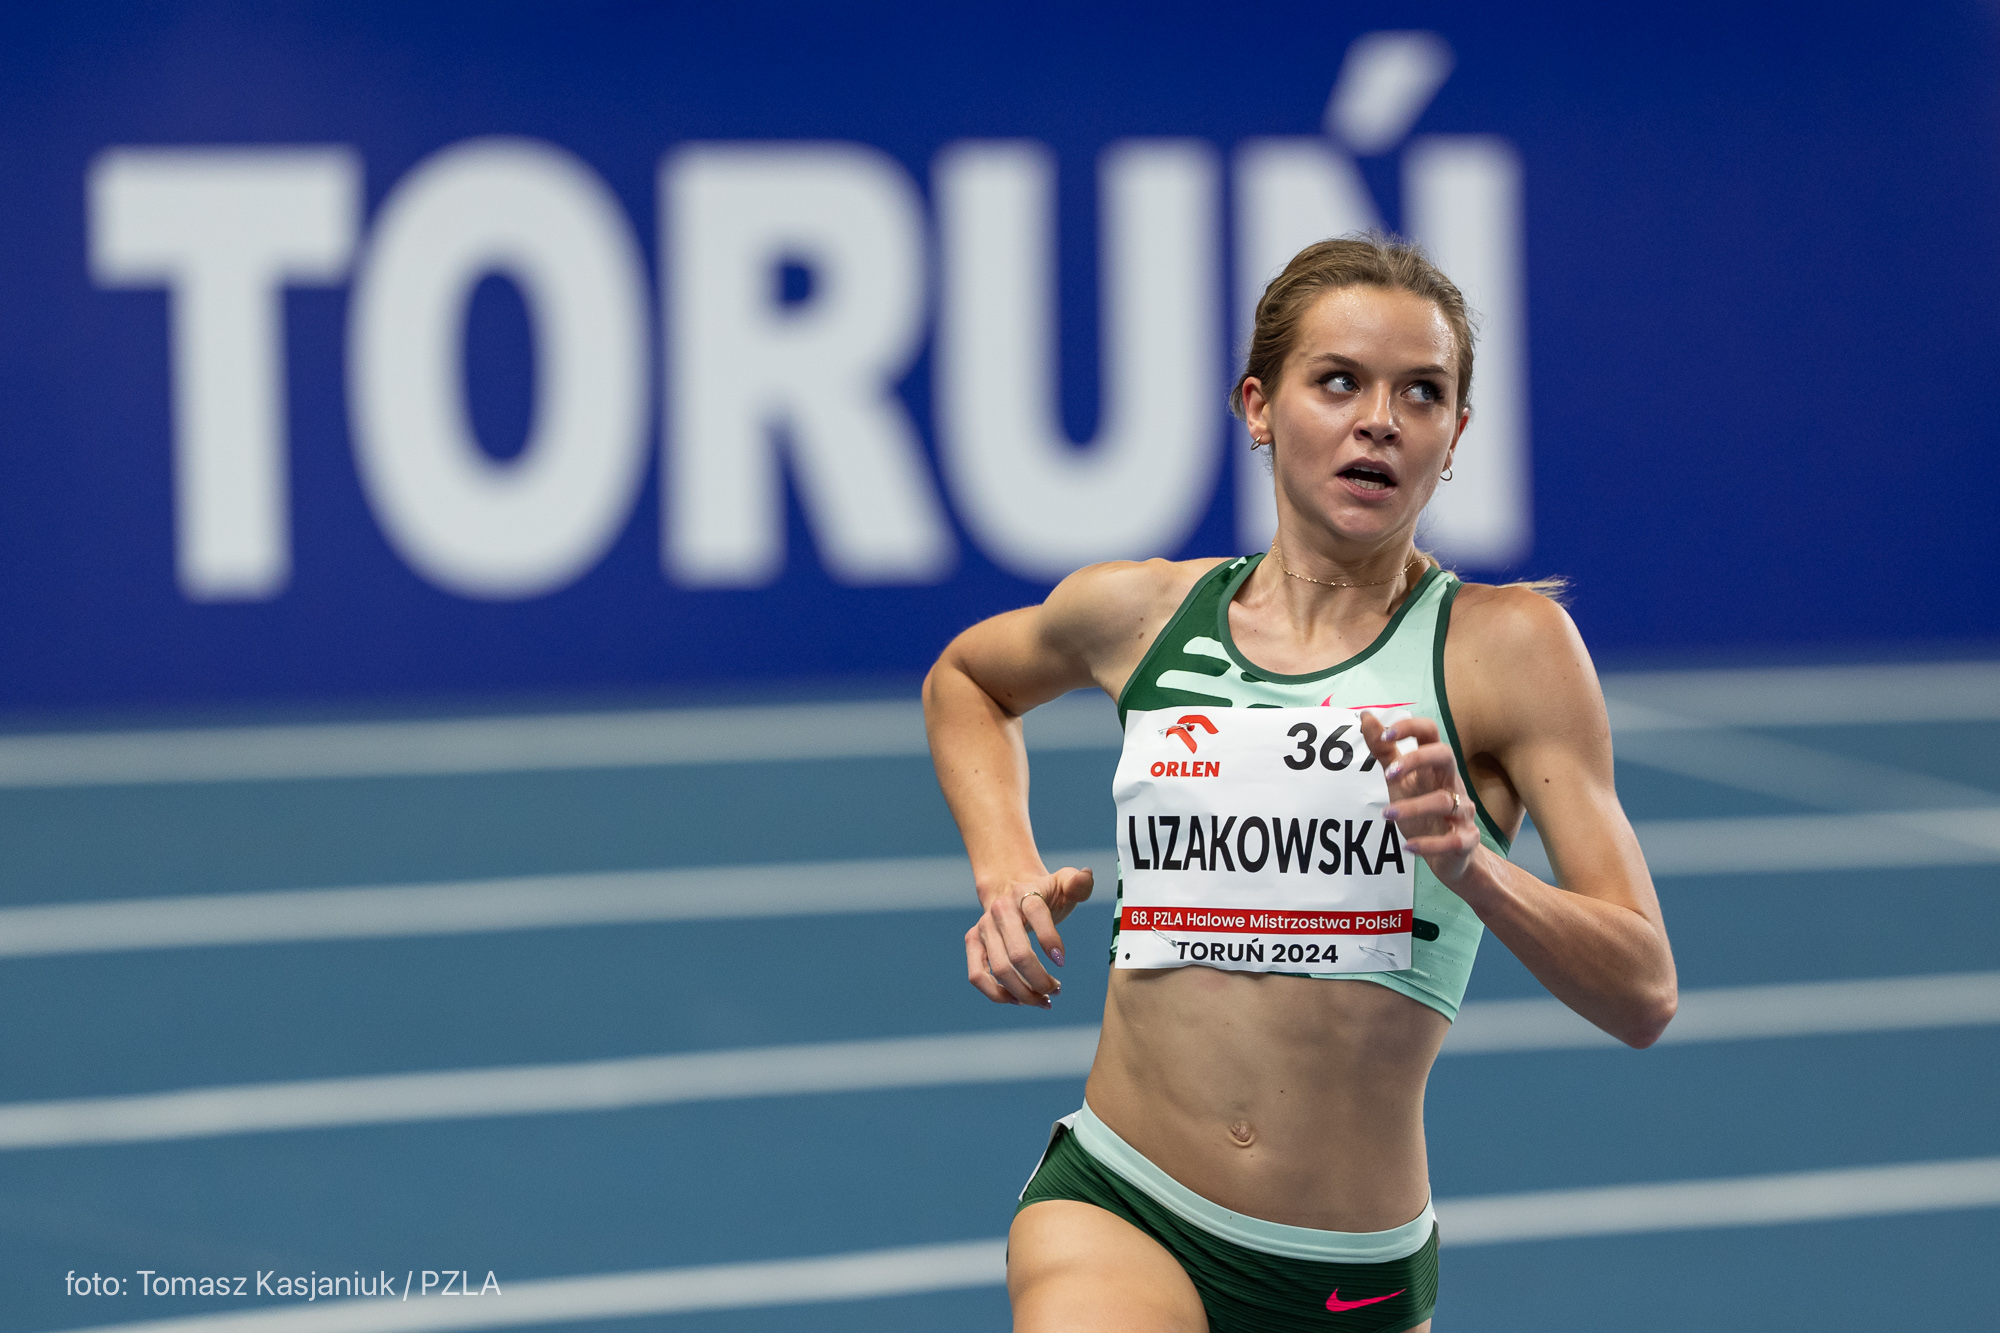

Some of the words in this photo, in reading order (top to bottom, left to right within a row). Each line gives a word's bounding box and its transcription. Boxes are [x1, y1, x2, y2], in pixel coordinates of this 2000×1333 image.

[86, 30, 1534, 602] TORUŃ
[1150, 761, 1221, 778] ORLEN
[1128, 815, 1406, 876] LIZAKOWSKA
[1131, 911, 1150, 926] 68.
[1153, 911, 1184, 926] PZLA
[1187, 913, 1246, 928] Halowe
[1250, 915, 1351, 930] Mistrzostwa
[1355, 914, 1402, 930] Polski
[1177, 938, 1264, 963] TORUŃ
[1271, 944, 1339, 963] 2024
